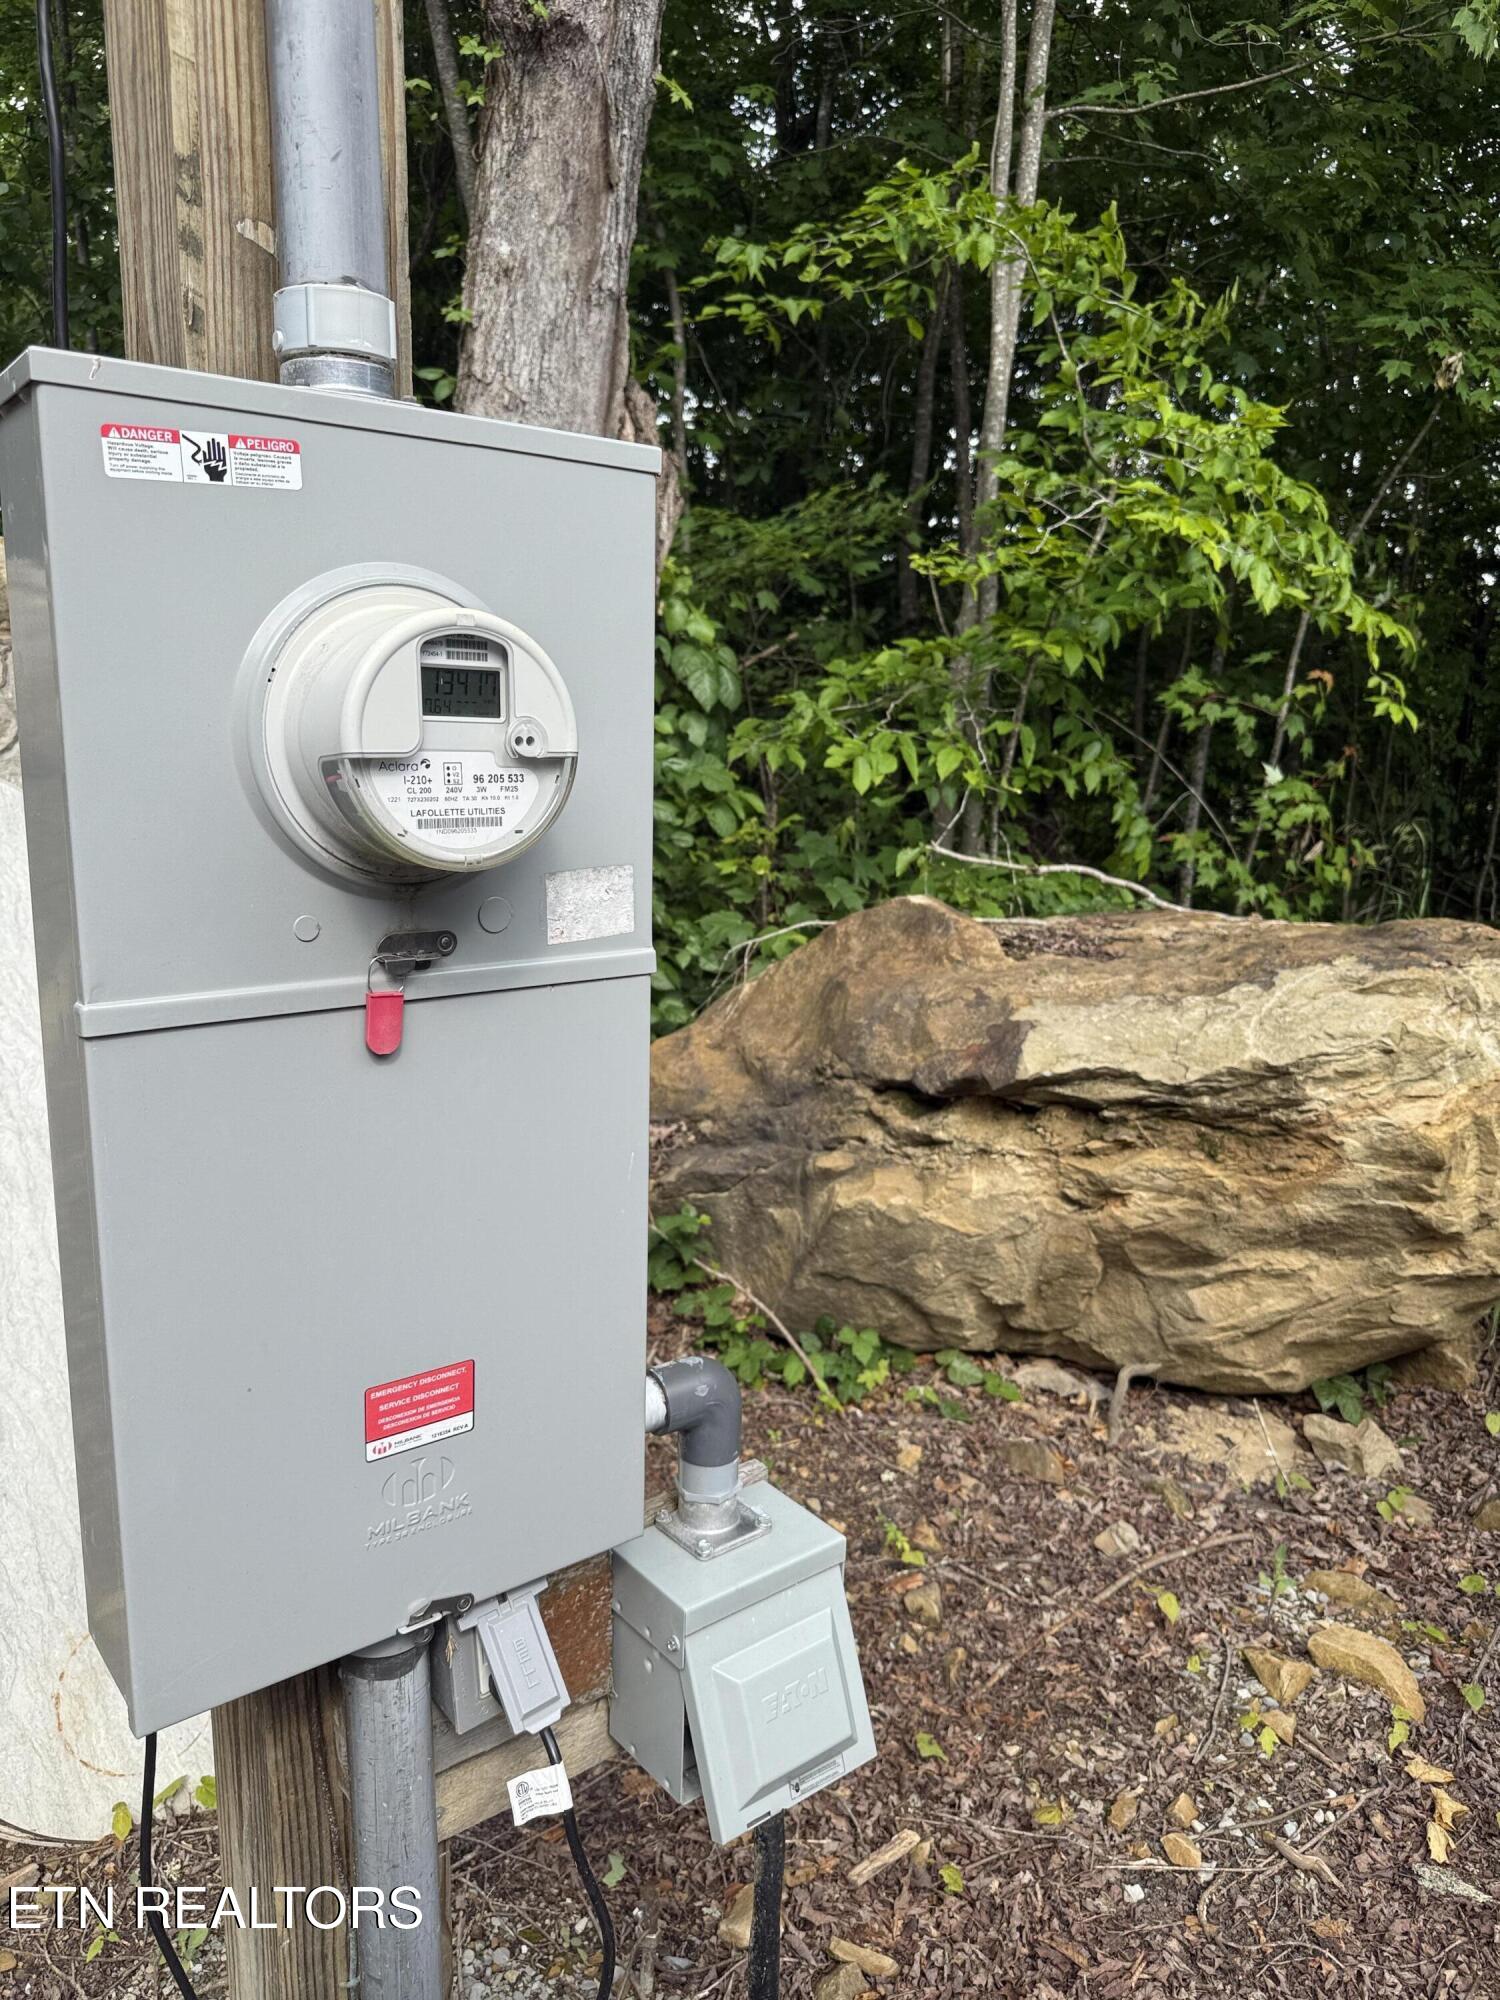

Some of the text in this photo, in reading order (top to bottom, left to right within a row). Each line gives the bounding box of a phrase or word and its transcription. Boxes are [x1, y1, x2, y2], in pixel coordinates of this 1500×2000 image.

[120, 427, 173, 442] DANGER
[247, 439, 294, 453] PELIGRO
[378, 761, 419, 772] Aclara
[403, 775, 433, 785] I-210+
[473, 773, 525, 784] 96 205 533
[419, 786, 432, 794] 200
[445, 786, 463, 794] 240V
[500, 785, 519, 793] FM2S
[410, 807, 506, 818] LAFOLLETTE UTILITIES
[370, 1380, 418, 1400] EMERGENCY
[379, 1383, 460, 1412] SERVICE DISCONNECT
[417, 1405, 426, 1413] DE
[422, 1411, 431, 1419] DE
[367, 1491, 470, 1541] MILBANK
[760, 1667, 829, 1725] EATON
